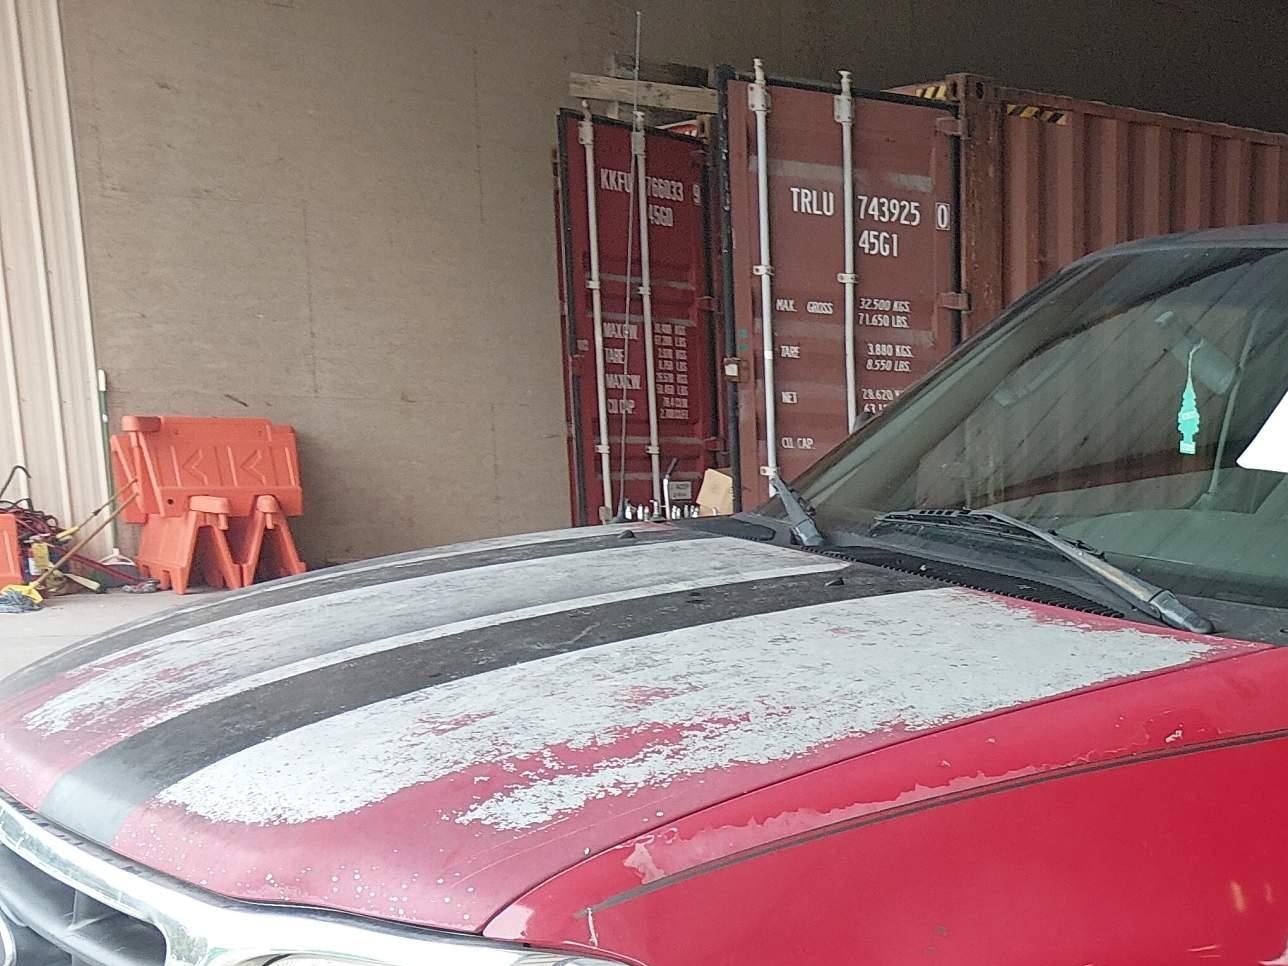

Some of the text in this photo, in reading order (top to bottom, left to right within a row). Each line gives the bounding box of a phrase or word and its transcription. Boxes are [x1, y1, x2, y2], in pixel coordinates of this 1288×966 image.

[790, 187, 948, 229] TRLU 743925 0
[858, 229, 898, 257] 45G1
[807, 301, 833, 315] GROSS
[781, 345, 800, 358] TARE
[782, 391, 798, 404] NET
